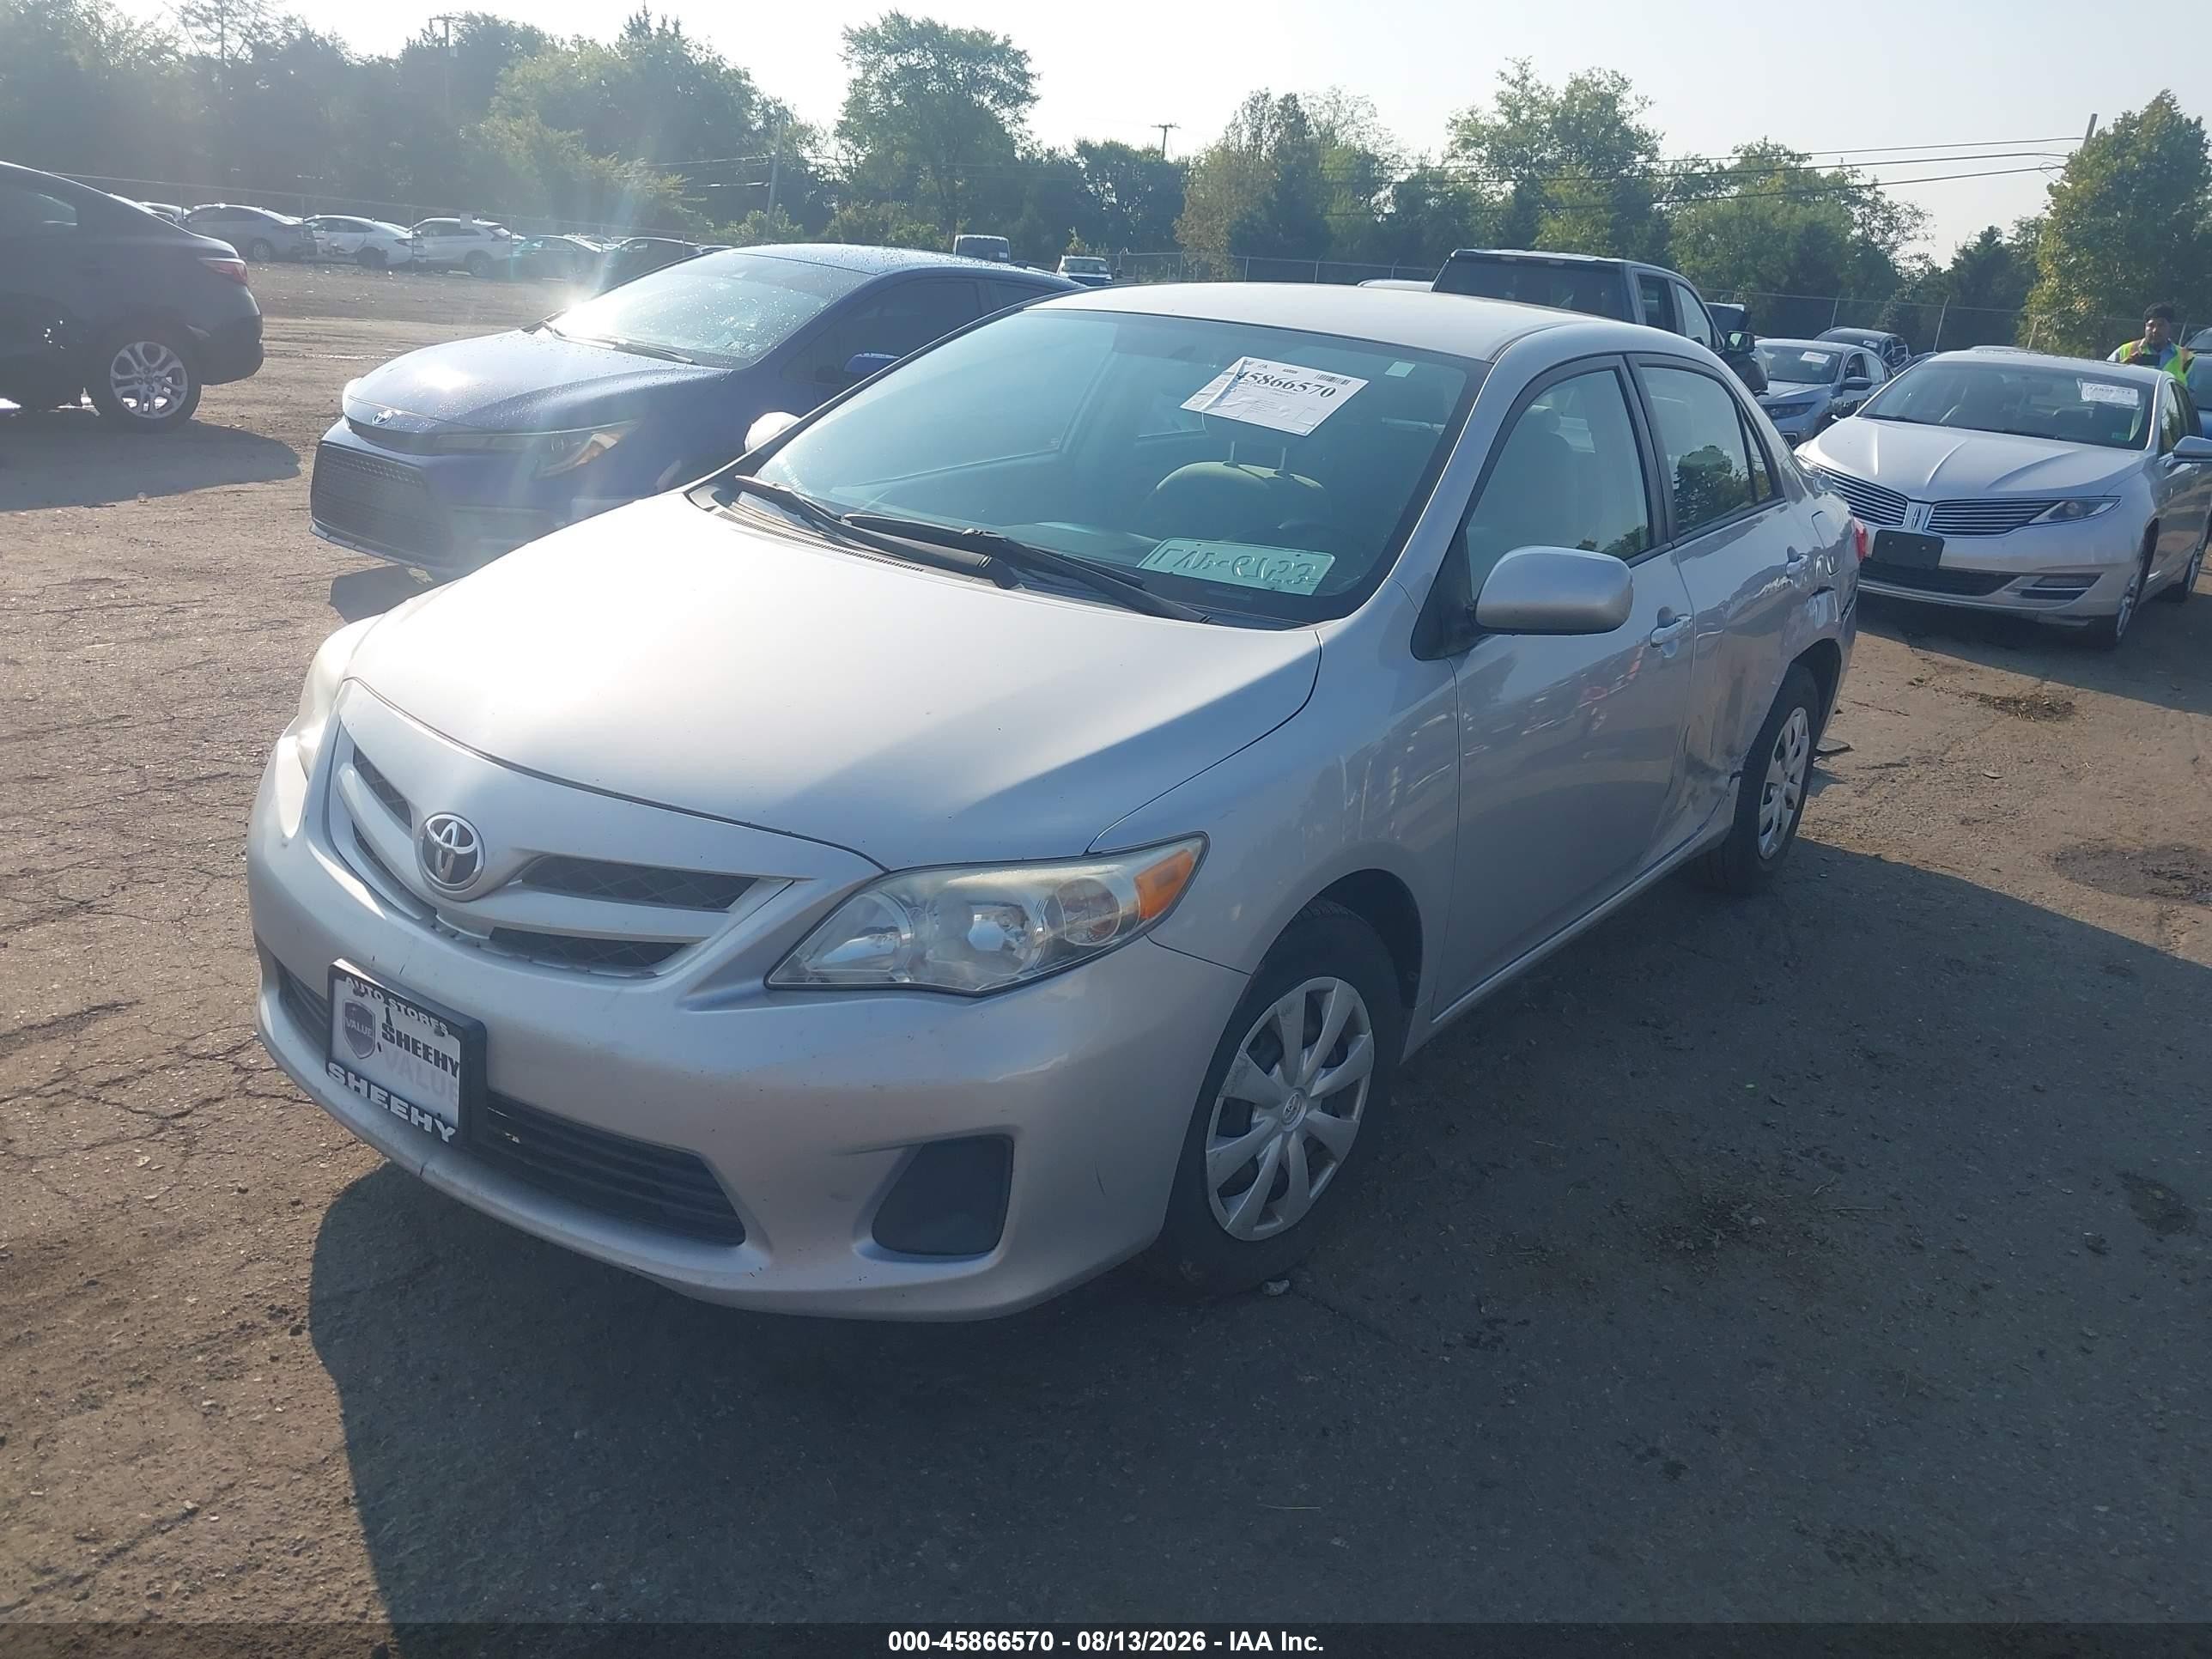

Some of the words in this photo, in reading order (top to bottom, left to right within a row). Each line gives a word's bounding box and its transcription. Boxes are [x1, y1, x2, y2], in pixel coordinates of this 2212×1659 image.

[1235, 370, 1337, 398] 45866570
[344, 1017, 373, 1038] VALUE
[345, 976, 385, 1002] AUTO
[388, 998, 449, 1037] STORES
[381, 1022, 460, 1079] SHEEHY
[328, 1061, 456, 1143] SHEEHY
